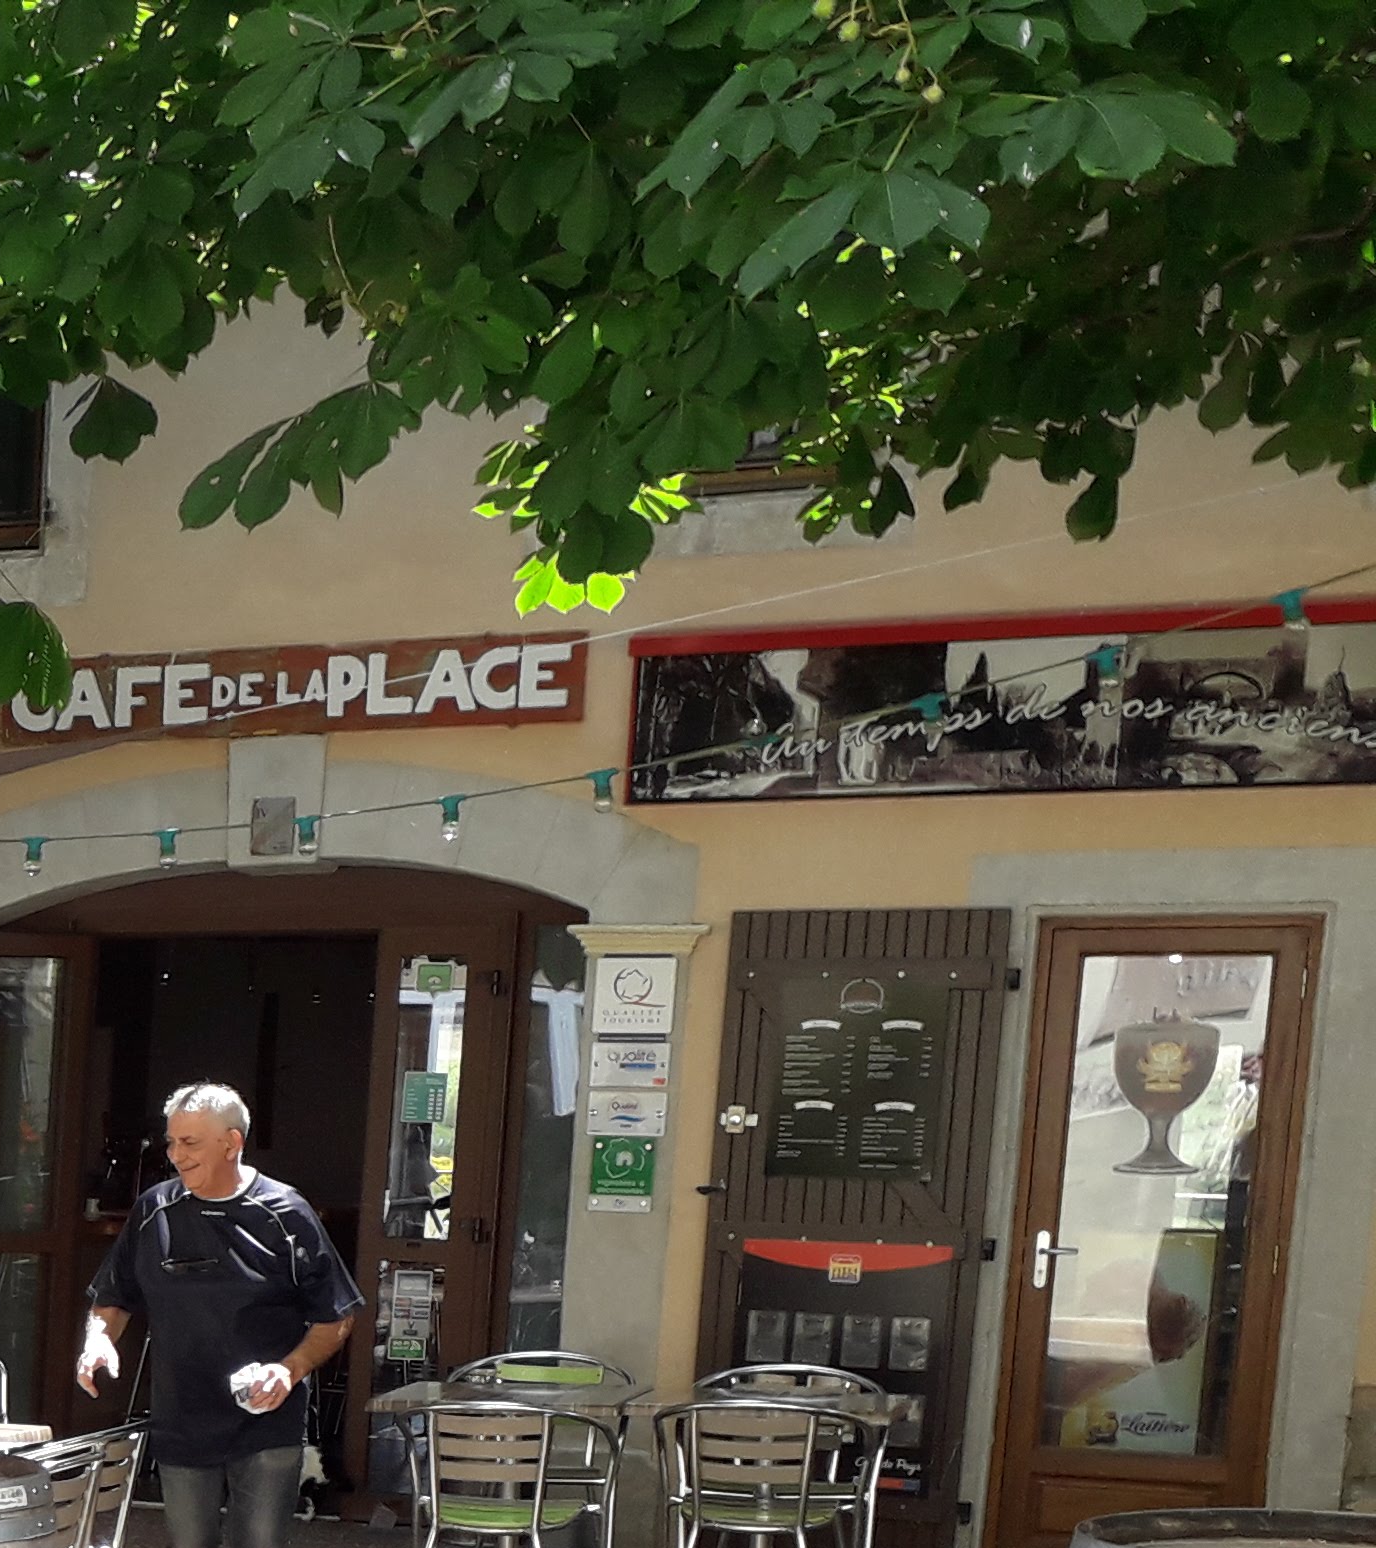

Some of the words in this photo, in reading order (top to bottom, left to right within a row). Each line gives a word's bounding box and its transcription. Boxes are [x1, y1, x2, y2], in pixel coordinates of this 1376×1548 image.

[211, 672, 265, 708] DE
[276, 668, 328, 704] LA
[326, 643, 573, 718] PLACE
